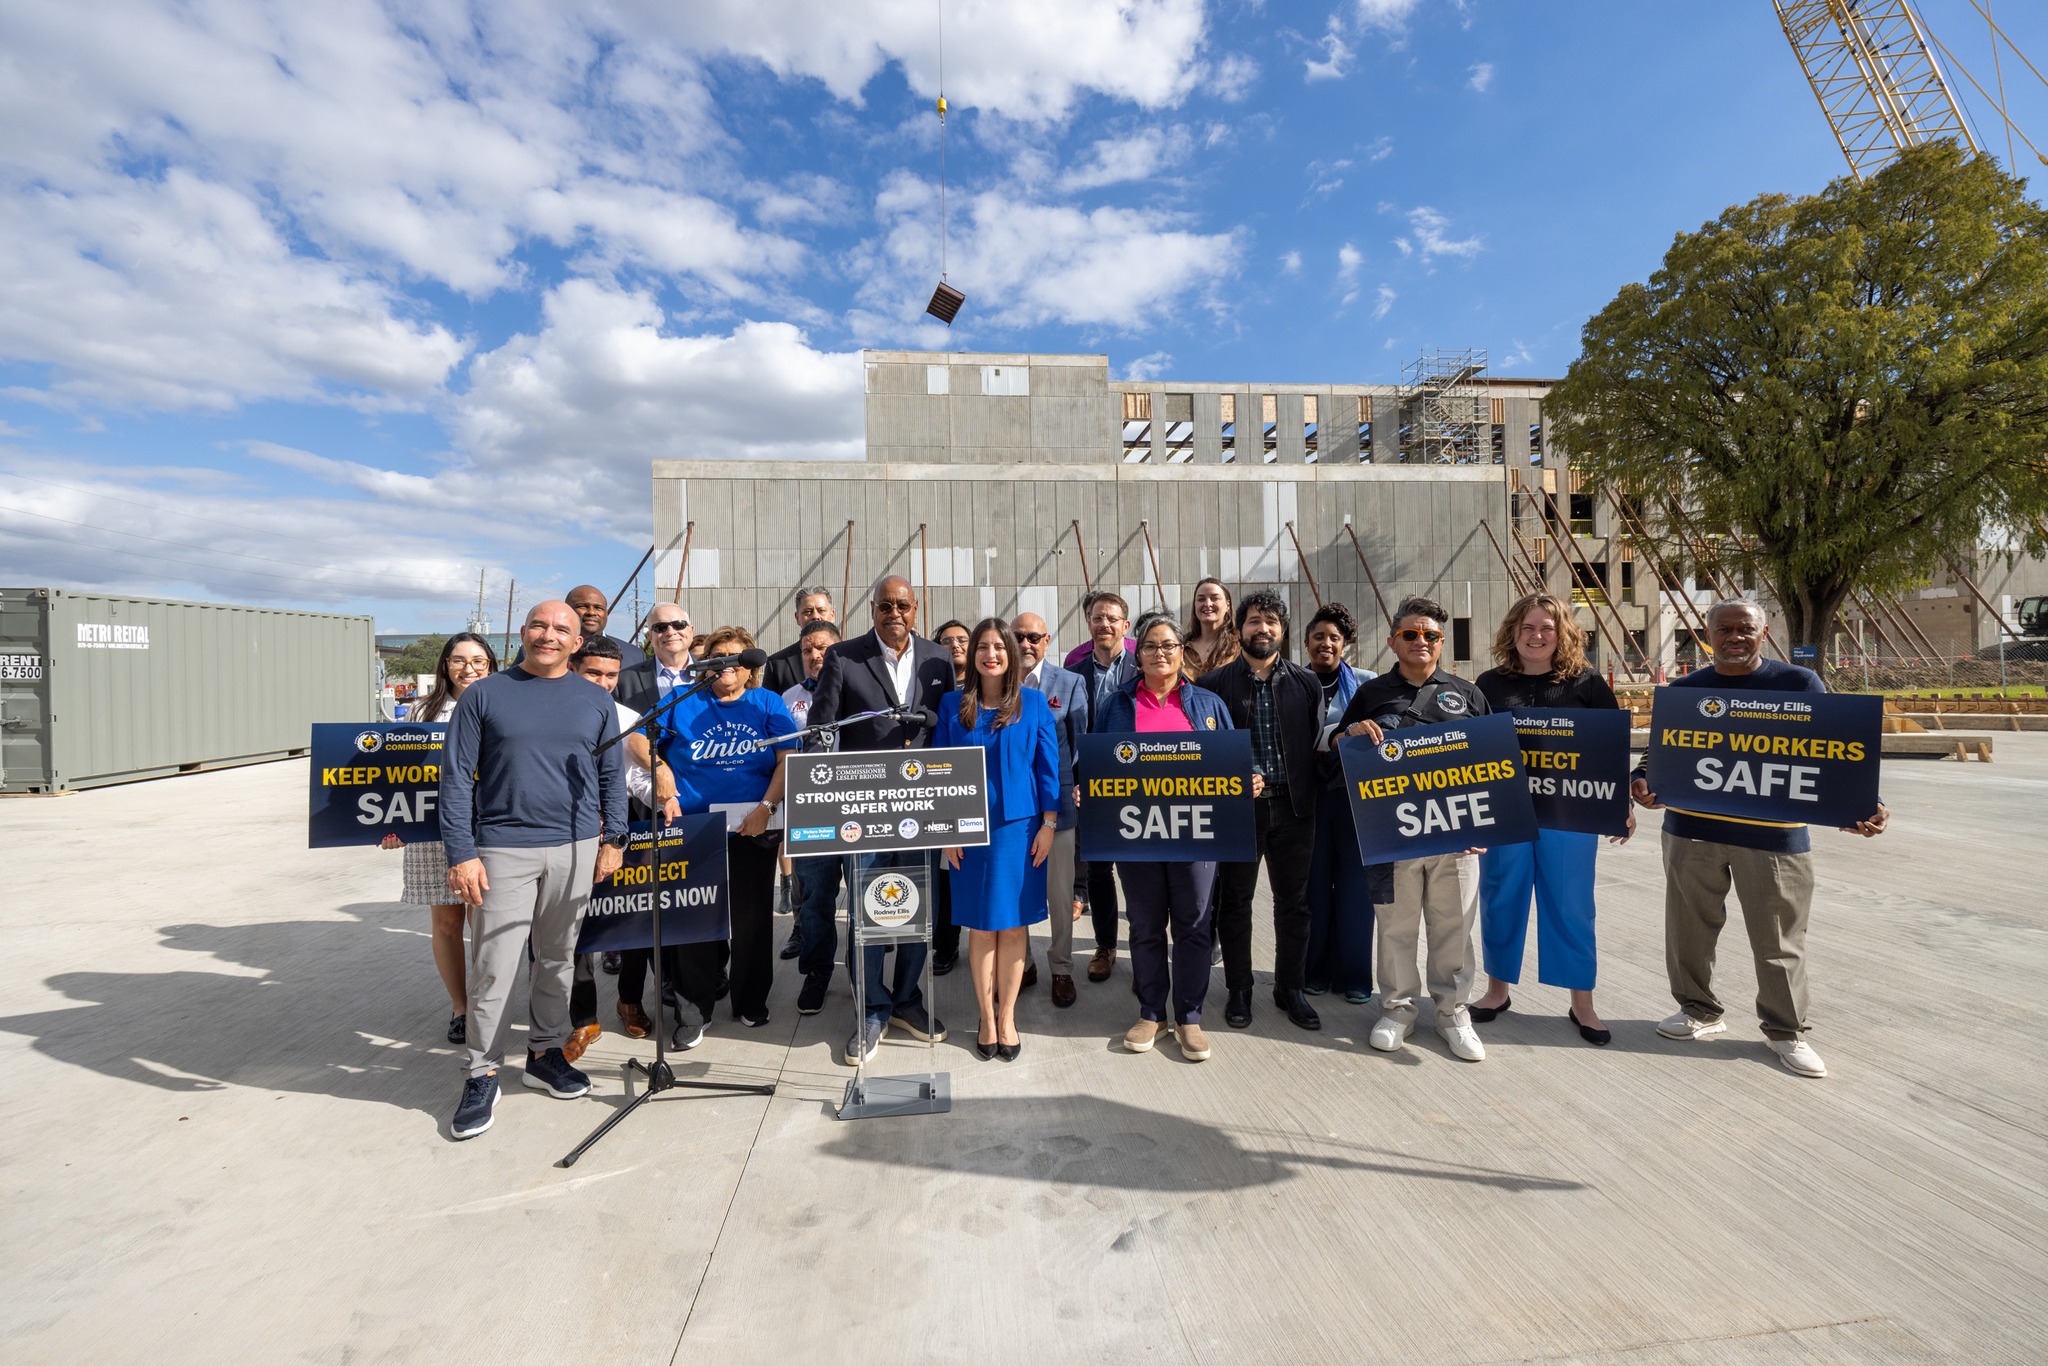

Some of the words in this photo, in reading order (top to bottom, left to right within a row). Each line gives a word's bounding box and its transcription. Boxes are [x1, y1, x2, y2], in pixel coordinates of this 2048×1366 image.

[0, 656, 41, 666] RENT
[1730, 699, 1780, 711] Rodney
[1784, 702, 1812, 712] Ellis
[1552, 718, 1574, 727] Ellis
[1730, 710, 1811, 722] COMMISSIONER
[386, 732, 429, 742] Rodney
[432, 732, 445, 741] Ell
[703, 724, 722, 738] IT'S
[727, 721, 758, 737] BETTER
[1515, 728, 1574, 736] OMMISSIONER
[1140, 742, 1178, 752] Rodney
[1180, 741, 1201, 751] Ellis
[1403, 736, 1443, 748] Rodney
[1444, 731, 1467, 742] Ellis
[1662, 729, 1724, 749] KEEP
[1729, 734, 1866, 761] WORKERS
[691, 737, 768, 760] Union
[1406, 742, 1469, 757] COMMISSIONER
[1520, 750, 1580, 770] TECT
[322, 767, 381, 785] KEEP
[1358, 775, 1409, 800] KEEP
[1412, 760, 1515, 792] WORKERS
[1694, 757, 1820, 801] SAFE
[796, 789, 875, 804] STRONGER
[879, 785, 977, 800] PROTECTIONS
[1089, 778, 1138, 797] KEEP
[1142, 777, 1243, 797] WORKERS
[1562, 779, 1616, 800] NOW
[356, 790, 438, 826] SAF
[841, 802, 888, 814] SAFER
[892, 800, 934, 812] WORK
[1396, 791, 1496, 837] SAFE
[1119, 805, 1214, 840] SAFE
[630, 830, 664, 841] Rodny
[665, 827, 683, 837] Ellis
[630, 838, 683, 850] COMMISIONER
[676, 885, 718, 908] NOW
